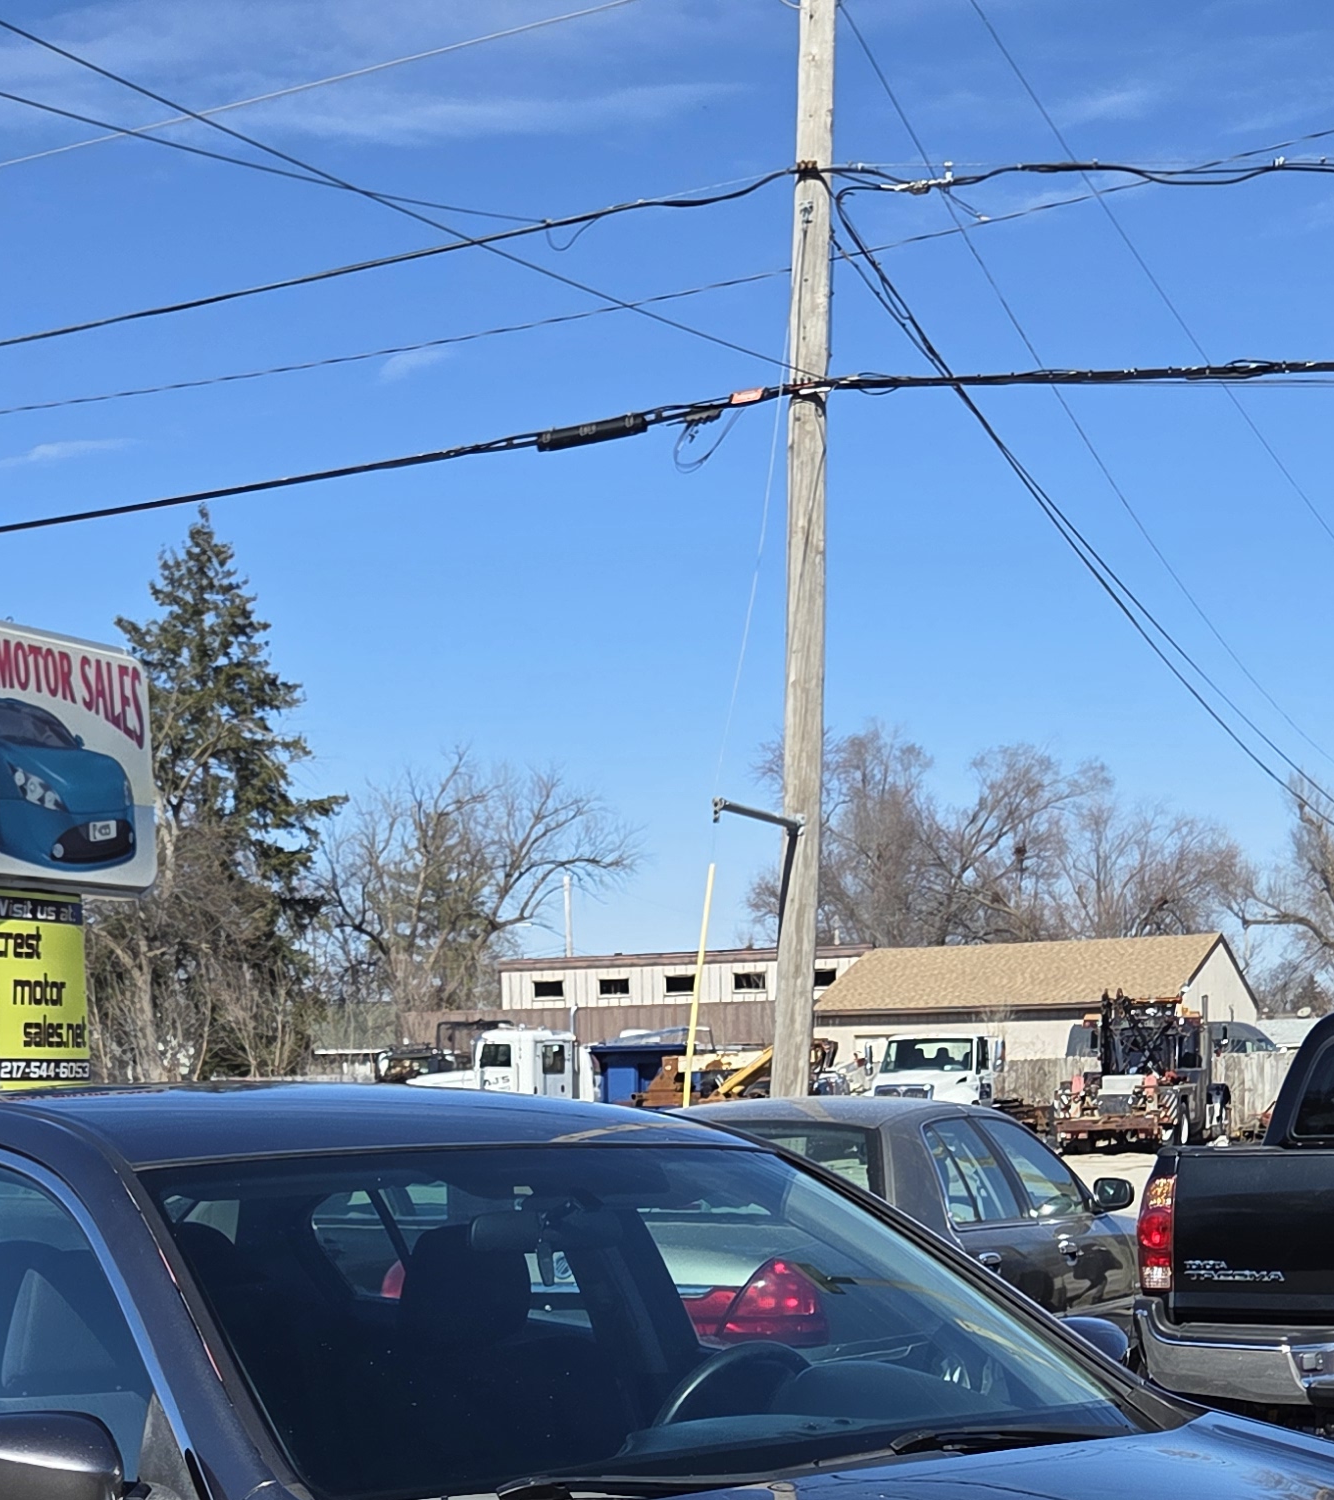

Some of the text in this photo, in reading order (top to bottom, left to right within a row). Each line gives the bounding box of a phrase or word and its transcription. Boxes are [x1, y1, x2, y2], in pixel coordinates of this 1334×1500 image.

[80, 655, 145, 750] SALES
[37, 905, 57, 921] us
[13, 972, 67, 1007] motor
[23, 1014, 88, 1049] sales.net
[0, 1062, 90, 1079] 217-544-6053
[1183, 1270, 1285, 1281] TACOMA
